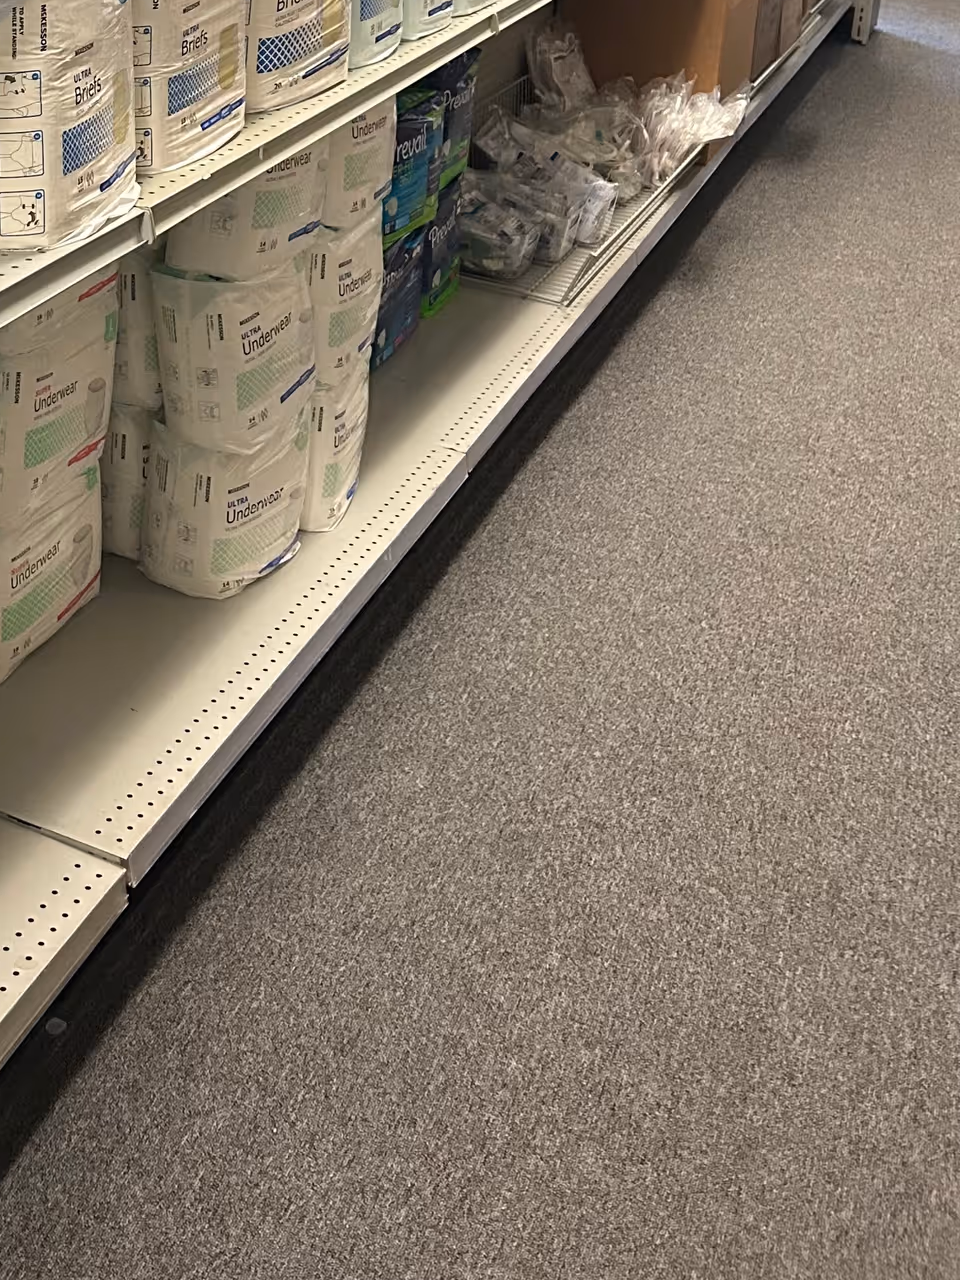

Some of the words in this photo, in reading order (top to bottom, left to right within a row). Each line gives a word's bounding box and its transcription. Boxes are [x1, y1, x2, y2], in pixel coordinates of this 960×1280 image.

[181, 29, 208, 57] Briefs
[73, 66, 92, 84] ULTRA
[74, 74, 102, 106] Briefs
[351, 115, 388, 140] Underwear
[396, 122, 428, 162] revail
[338, 267, 374, 298] Underwear
[240, 324, 262, 341] ULTRA
[242, 312, 293, 356] Underwear
[33, 380, 79, 413] Underwear
[226, 486, 285, 524] Underwear
[227, 495, 249, 509] ULTRA
[10, 540, 61, 590] Underwear
